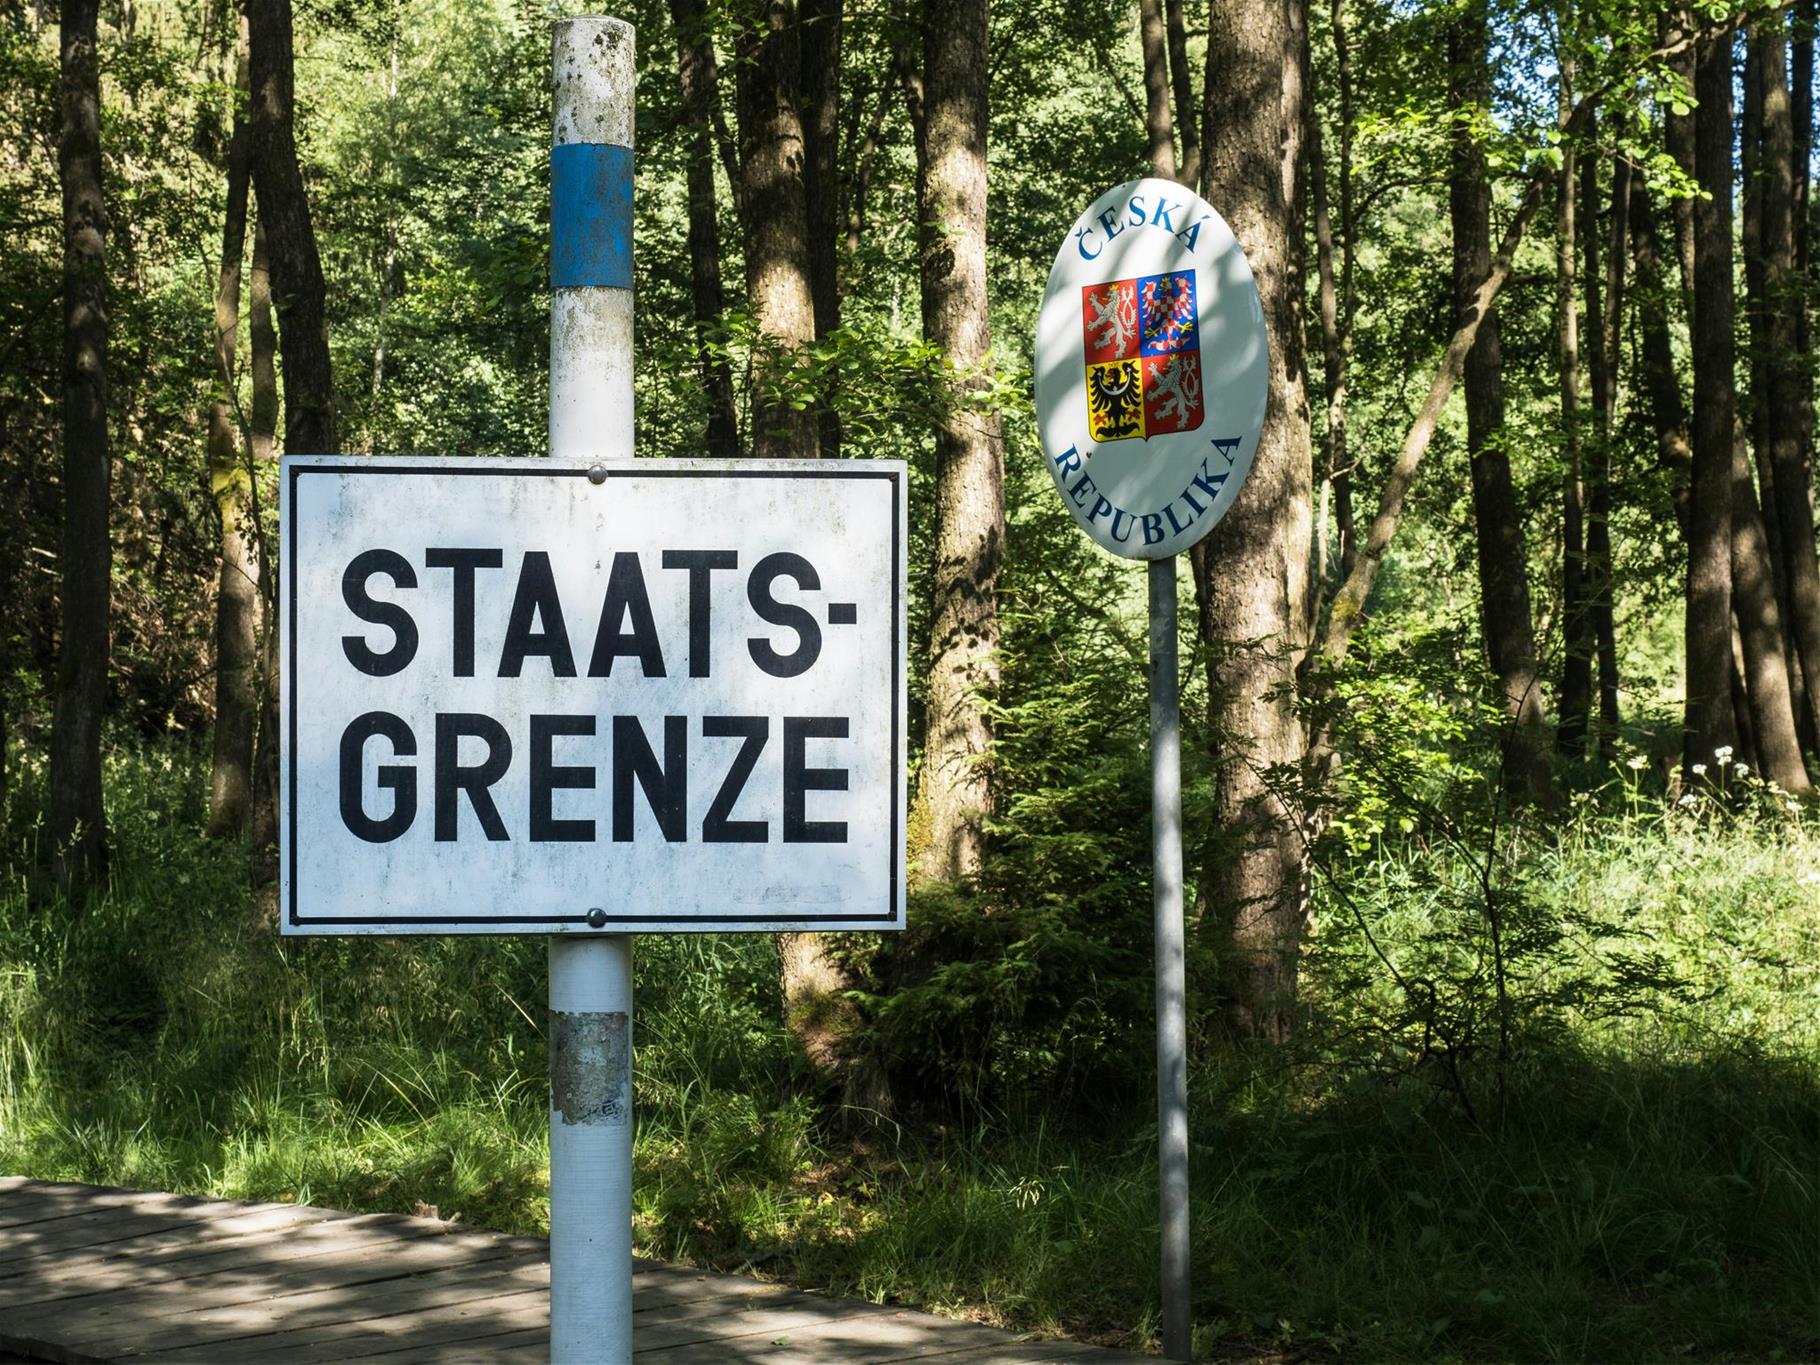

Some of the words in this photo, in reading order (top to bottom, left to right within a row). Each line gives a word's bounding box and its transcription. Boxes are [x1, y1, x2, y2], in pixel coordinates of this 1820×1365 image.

[1074, 195, 1212, 261] ČESKÁ
[1053, 435, 1242, 546] REPUBLIKA
[341, 547, 858, 678] STAATS-
[338, 711, 850, 844] GRENZE
